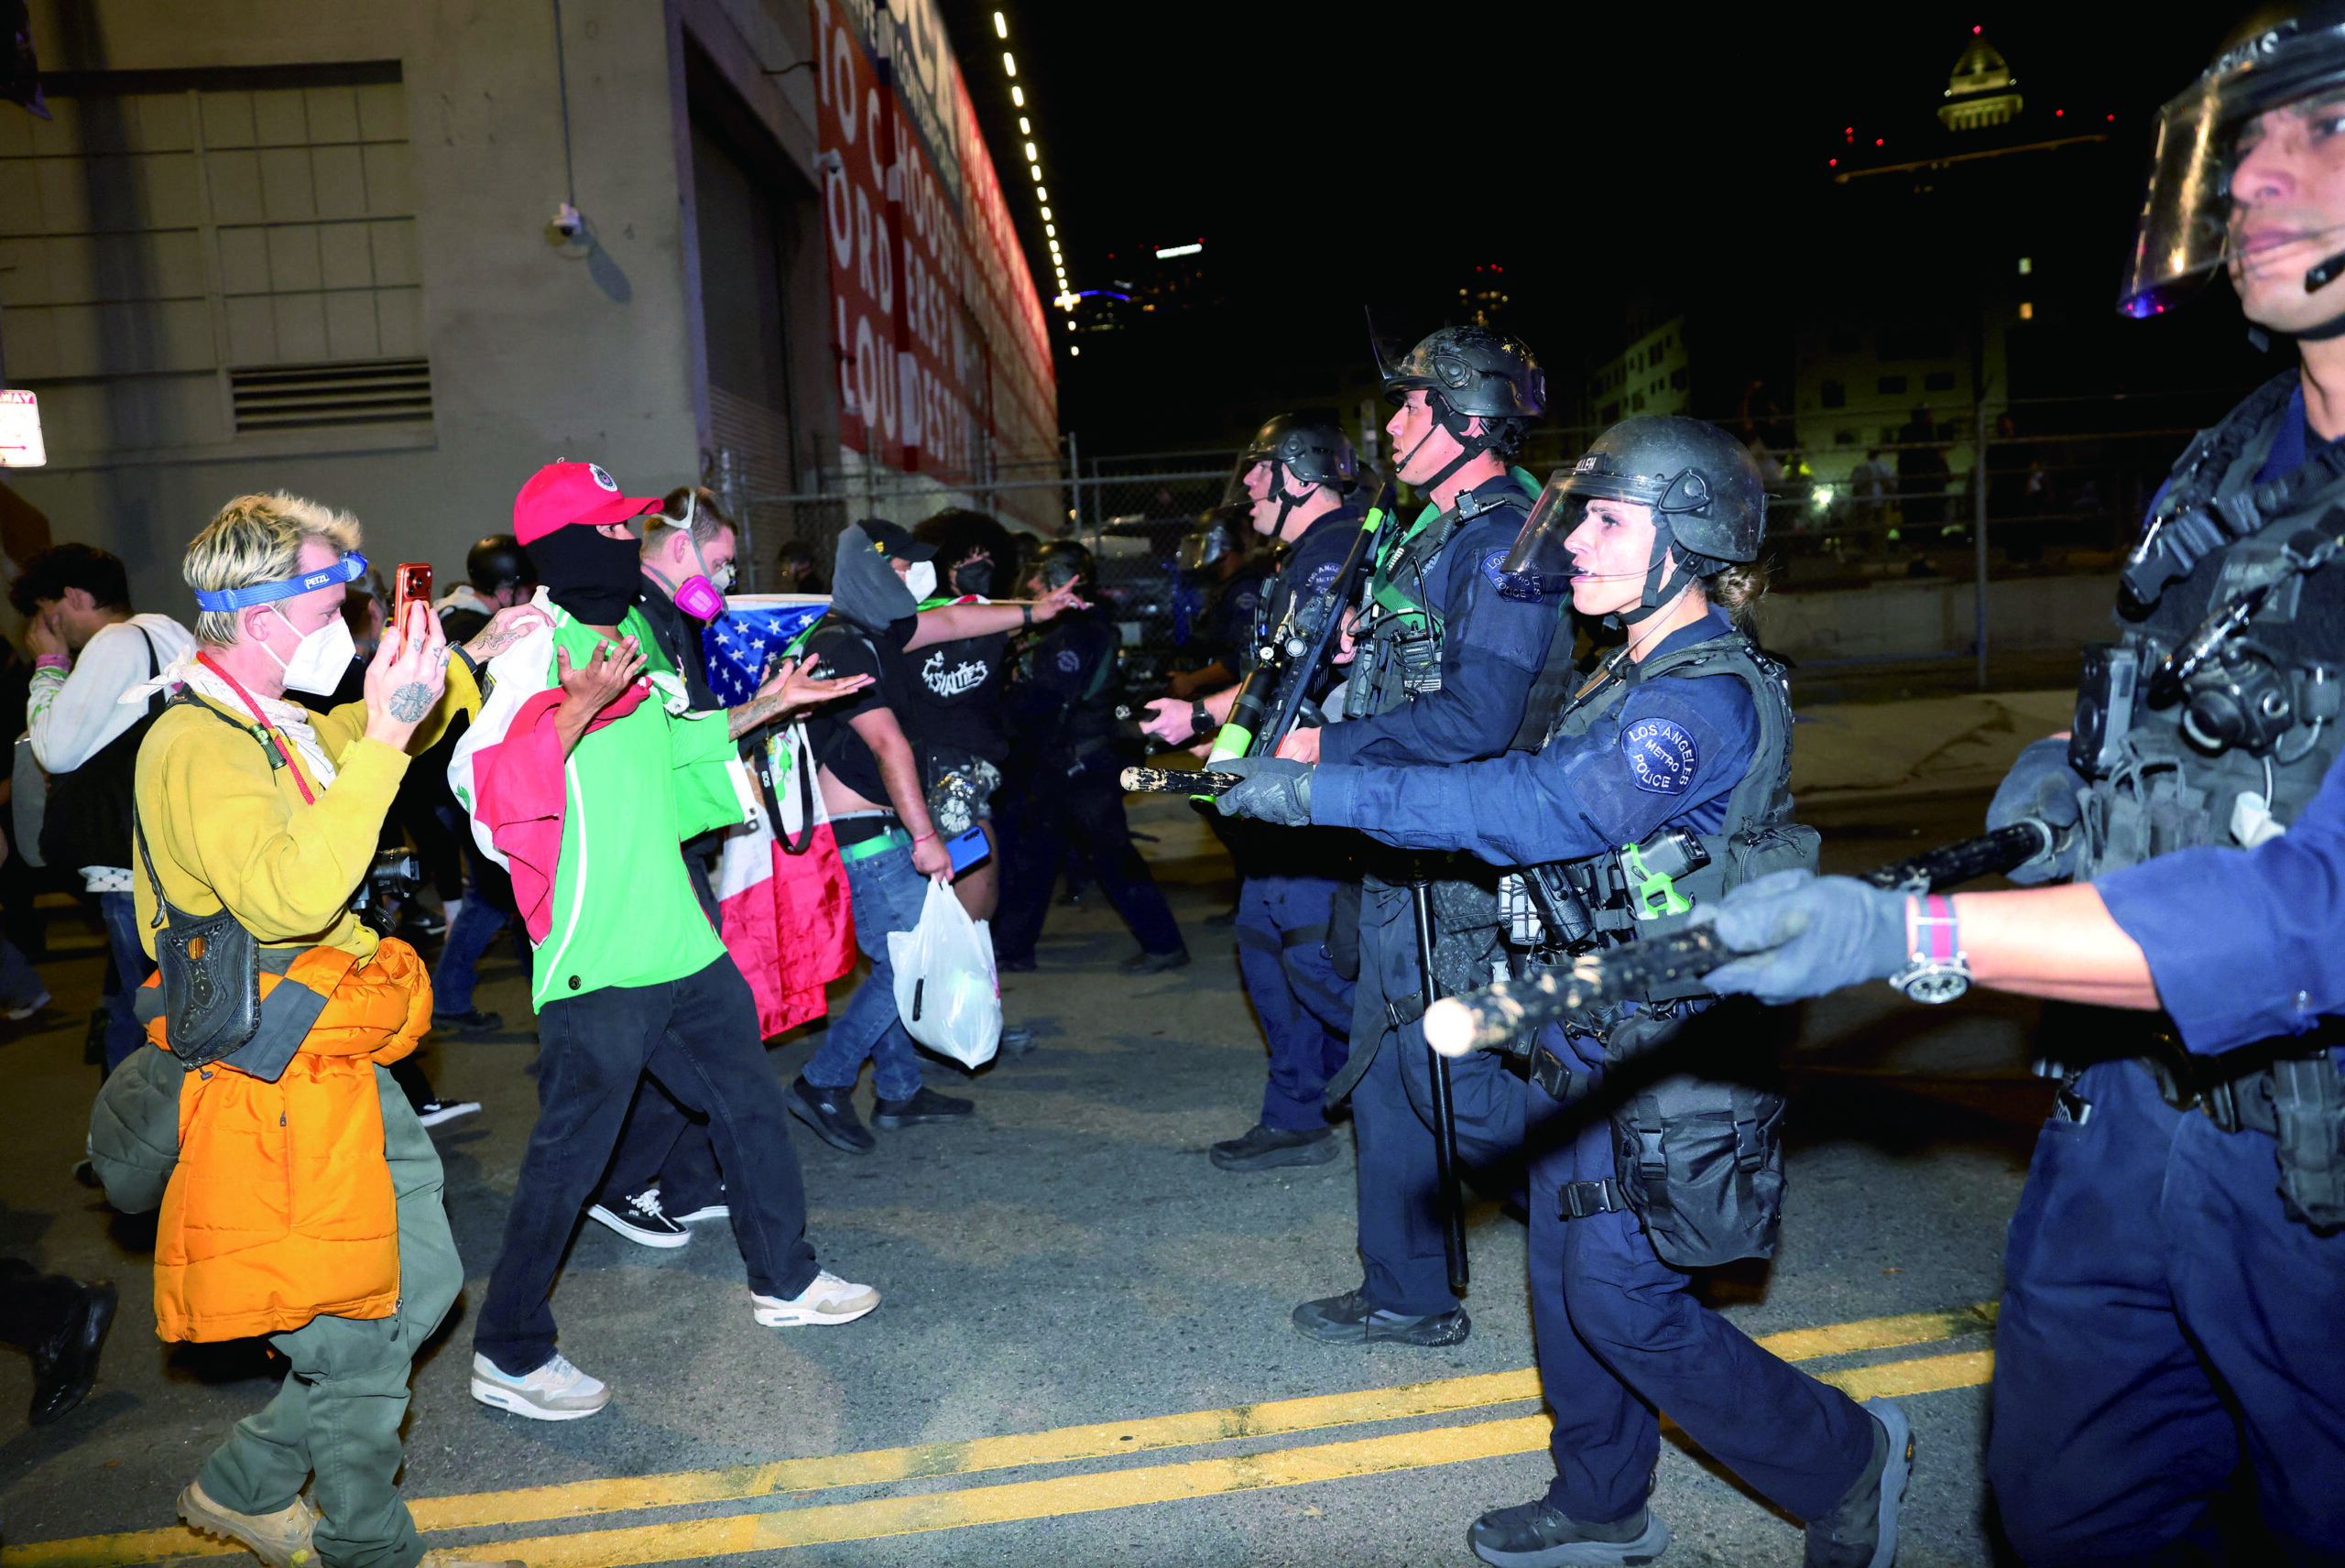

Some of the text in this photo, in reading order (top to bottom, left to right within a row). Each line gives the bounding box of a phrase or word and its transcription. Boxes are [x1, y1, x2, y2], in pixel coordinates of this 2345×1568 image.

[305, 574, 331, 590] PETZL
[1494, 576, 1526, 597] POLICE
[1628, 724, 1695, 786] LOS ANGELES
[1632, 753, 1672, 788] POLICE
[1645, 739, 1680, 772] METRO
